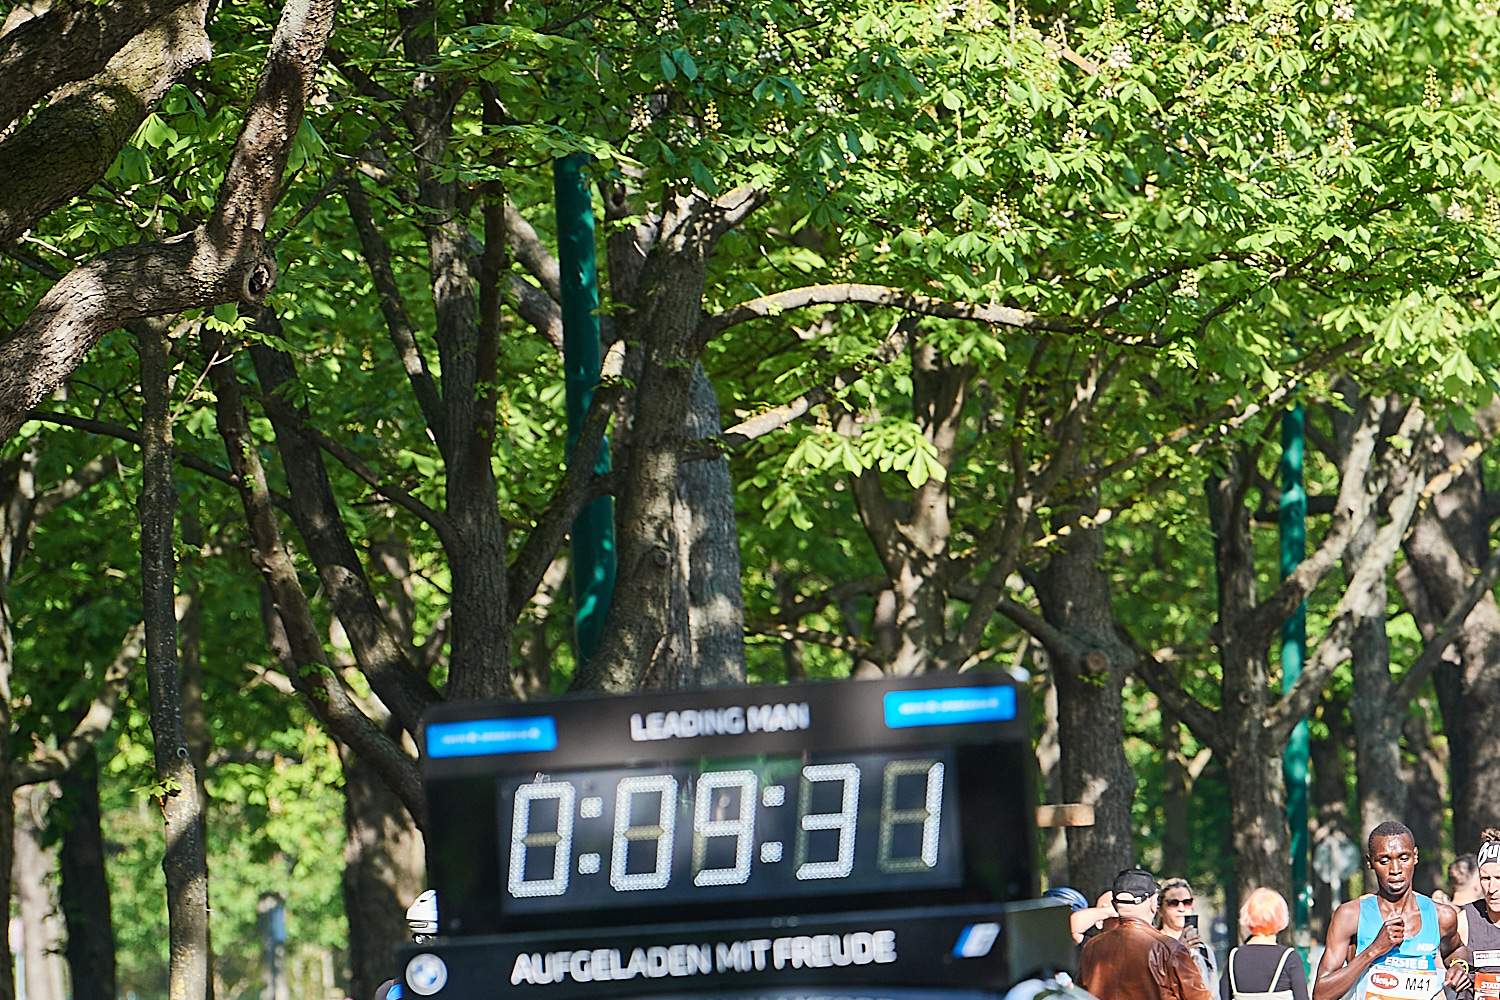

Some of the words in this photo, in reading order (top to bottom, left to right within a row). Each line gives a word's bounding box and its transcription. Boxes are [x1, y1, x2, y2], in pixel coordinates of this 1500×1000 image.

[630, 706, 745, 741] LEADING
[746, 702, 811, 733] MAN
[507, 762, 944, 898] 0:09:31
[510, 943, 713, 985] AUFGELADEN
[714, 938, 772, 974] MIT
[772, 930, 897, 970] FREUDE
[1385, 957, 1417, 969] ERSTE
[1405, 977, 1431, 992] M41
